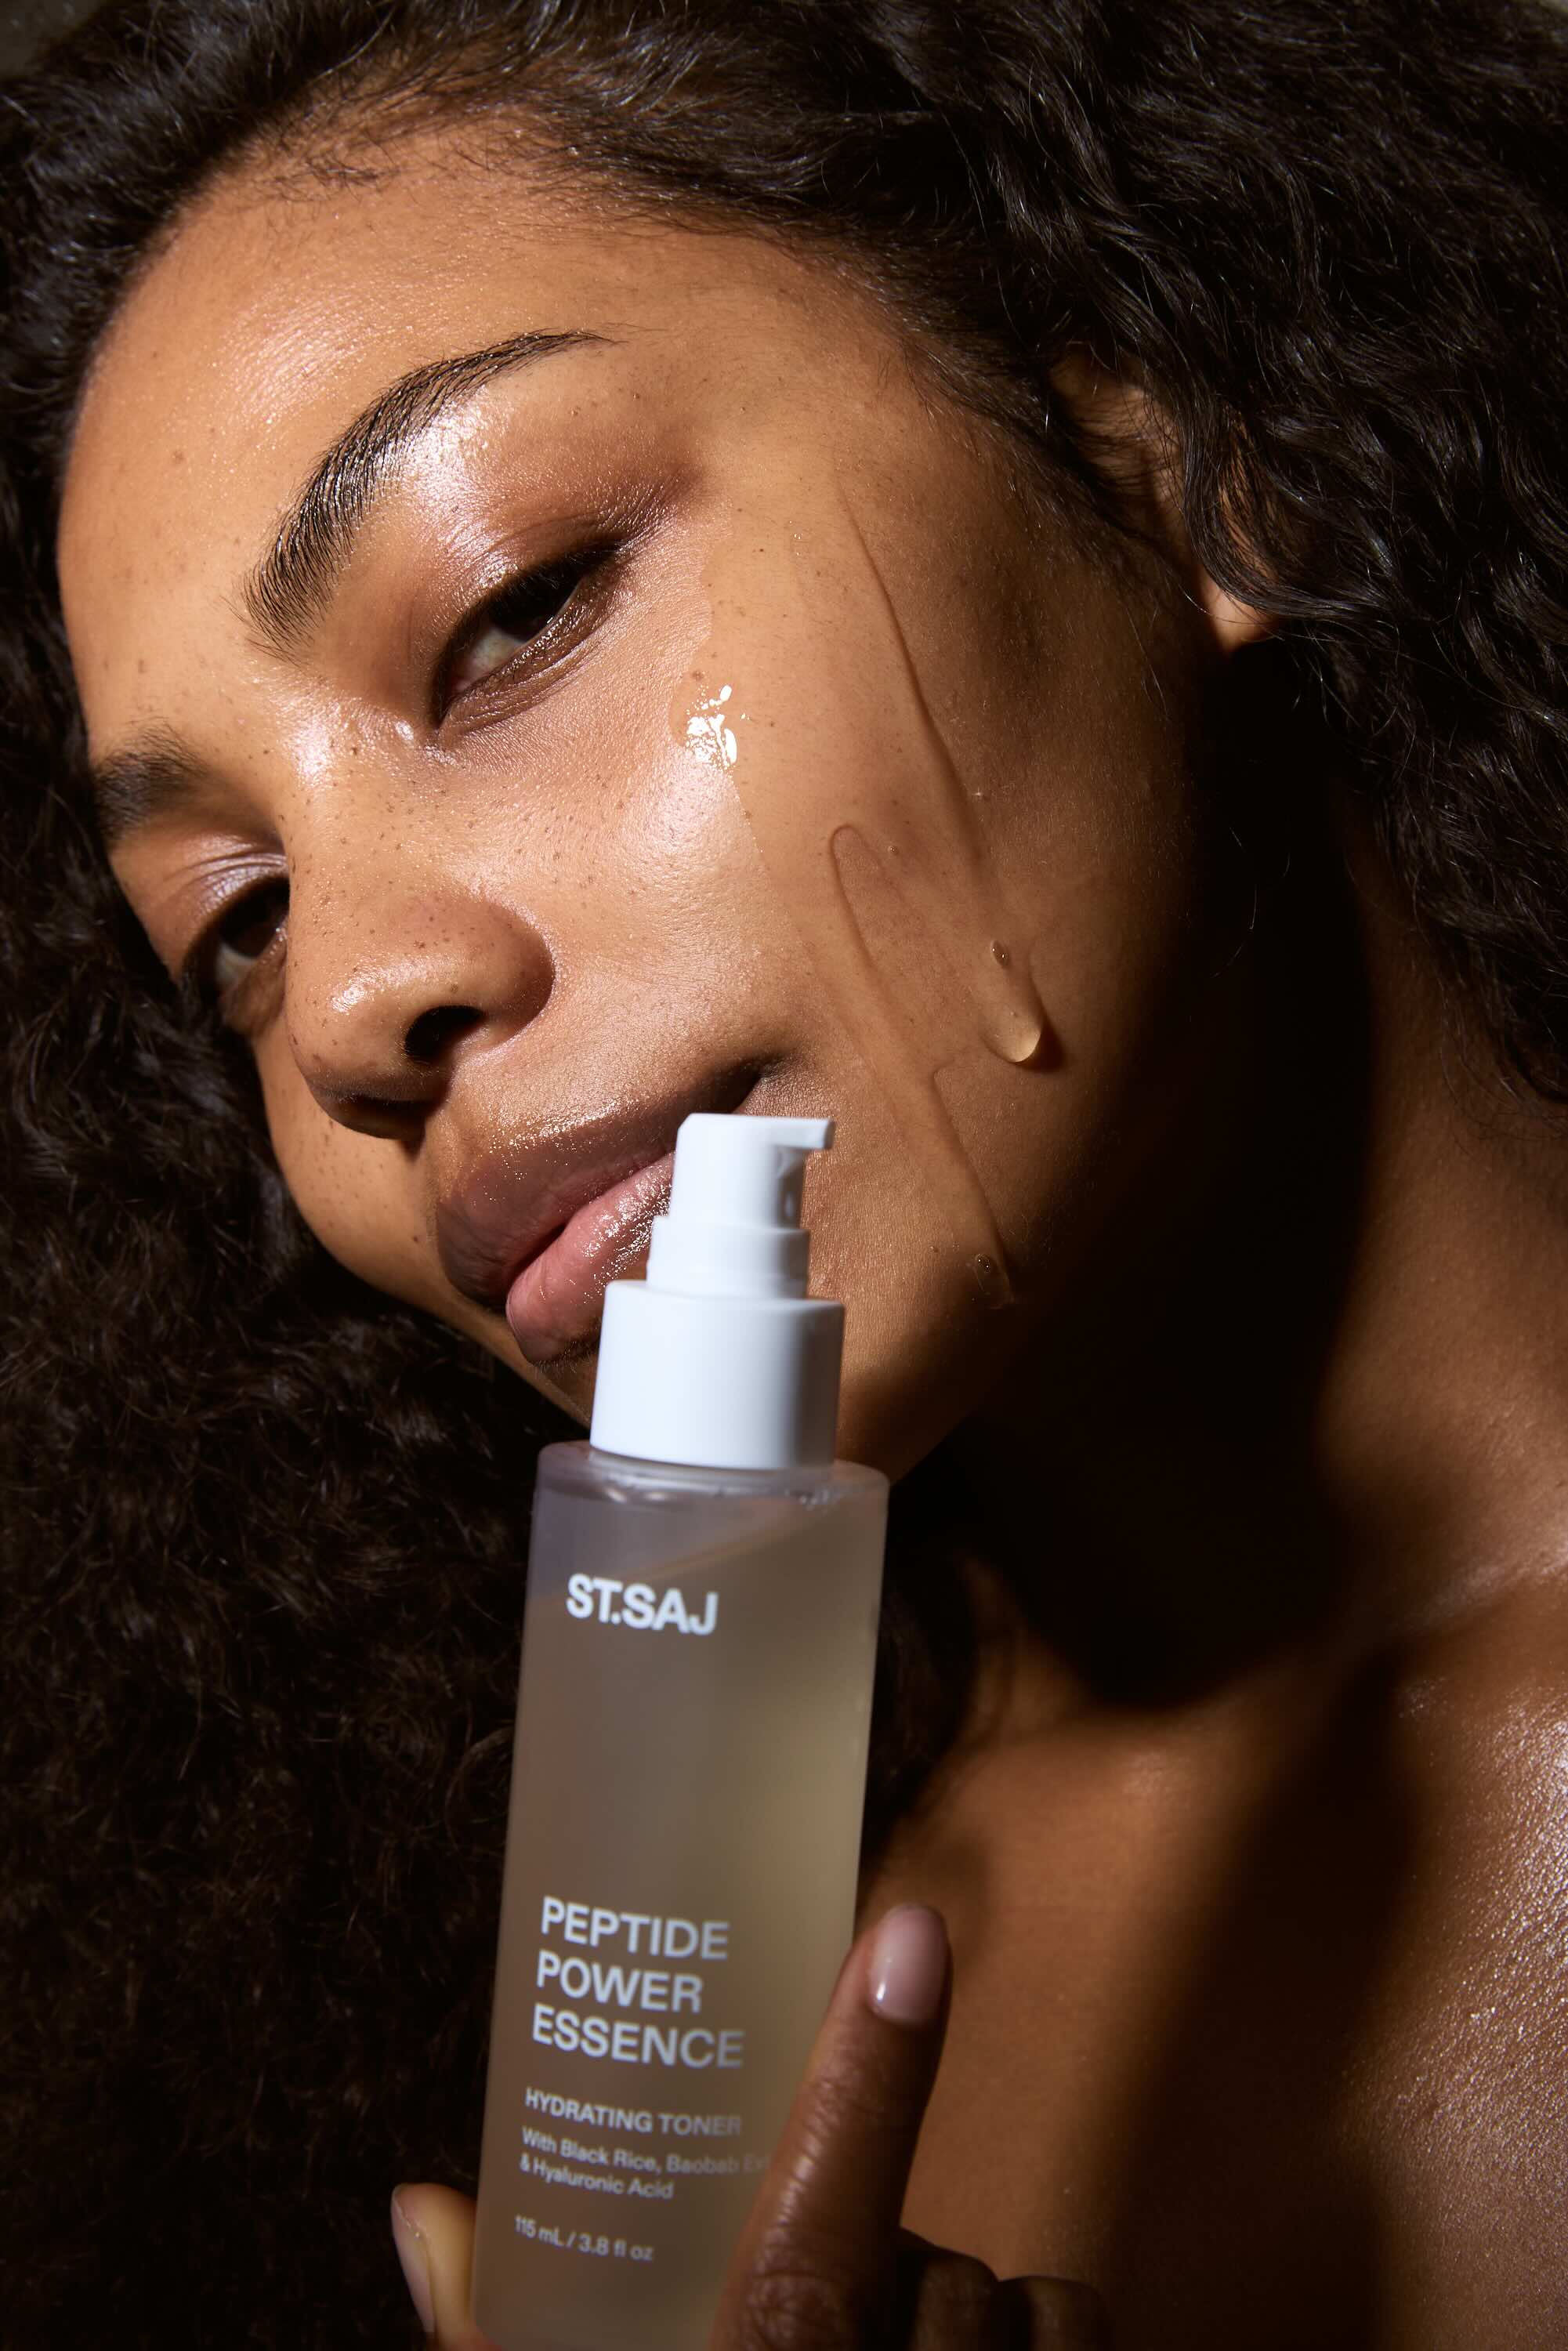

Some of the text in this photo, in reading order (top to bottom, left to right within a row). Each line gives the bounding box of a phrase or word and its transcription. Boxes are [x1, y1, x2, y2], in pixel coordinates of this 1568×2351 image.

[566, 1572, 719, 1636] ST.SAJ
[541, 1895, 730, 1960] PEPTIDE
[537, 1949, 703, 2013] POWER
[532, 2002, 744, 2069] ESSENCE
[525, 2087, 741, 2135] HYDRATING TONER
[520, 2153, 674, 2199] & Hyaluronic Acid
[522, 2126, 556, 2154] With
[560, 2138, 609, 2165] Black
[614, 2150, 662, 2175] Rice,
[666, 2154, 740, 2175] Baobab
[516, 2215, 654, 2261] 115 mL / 3.8 fl oz
